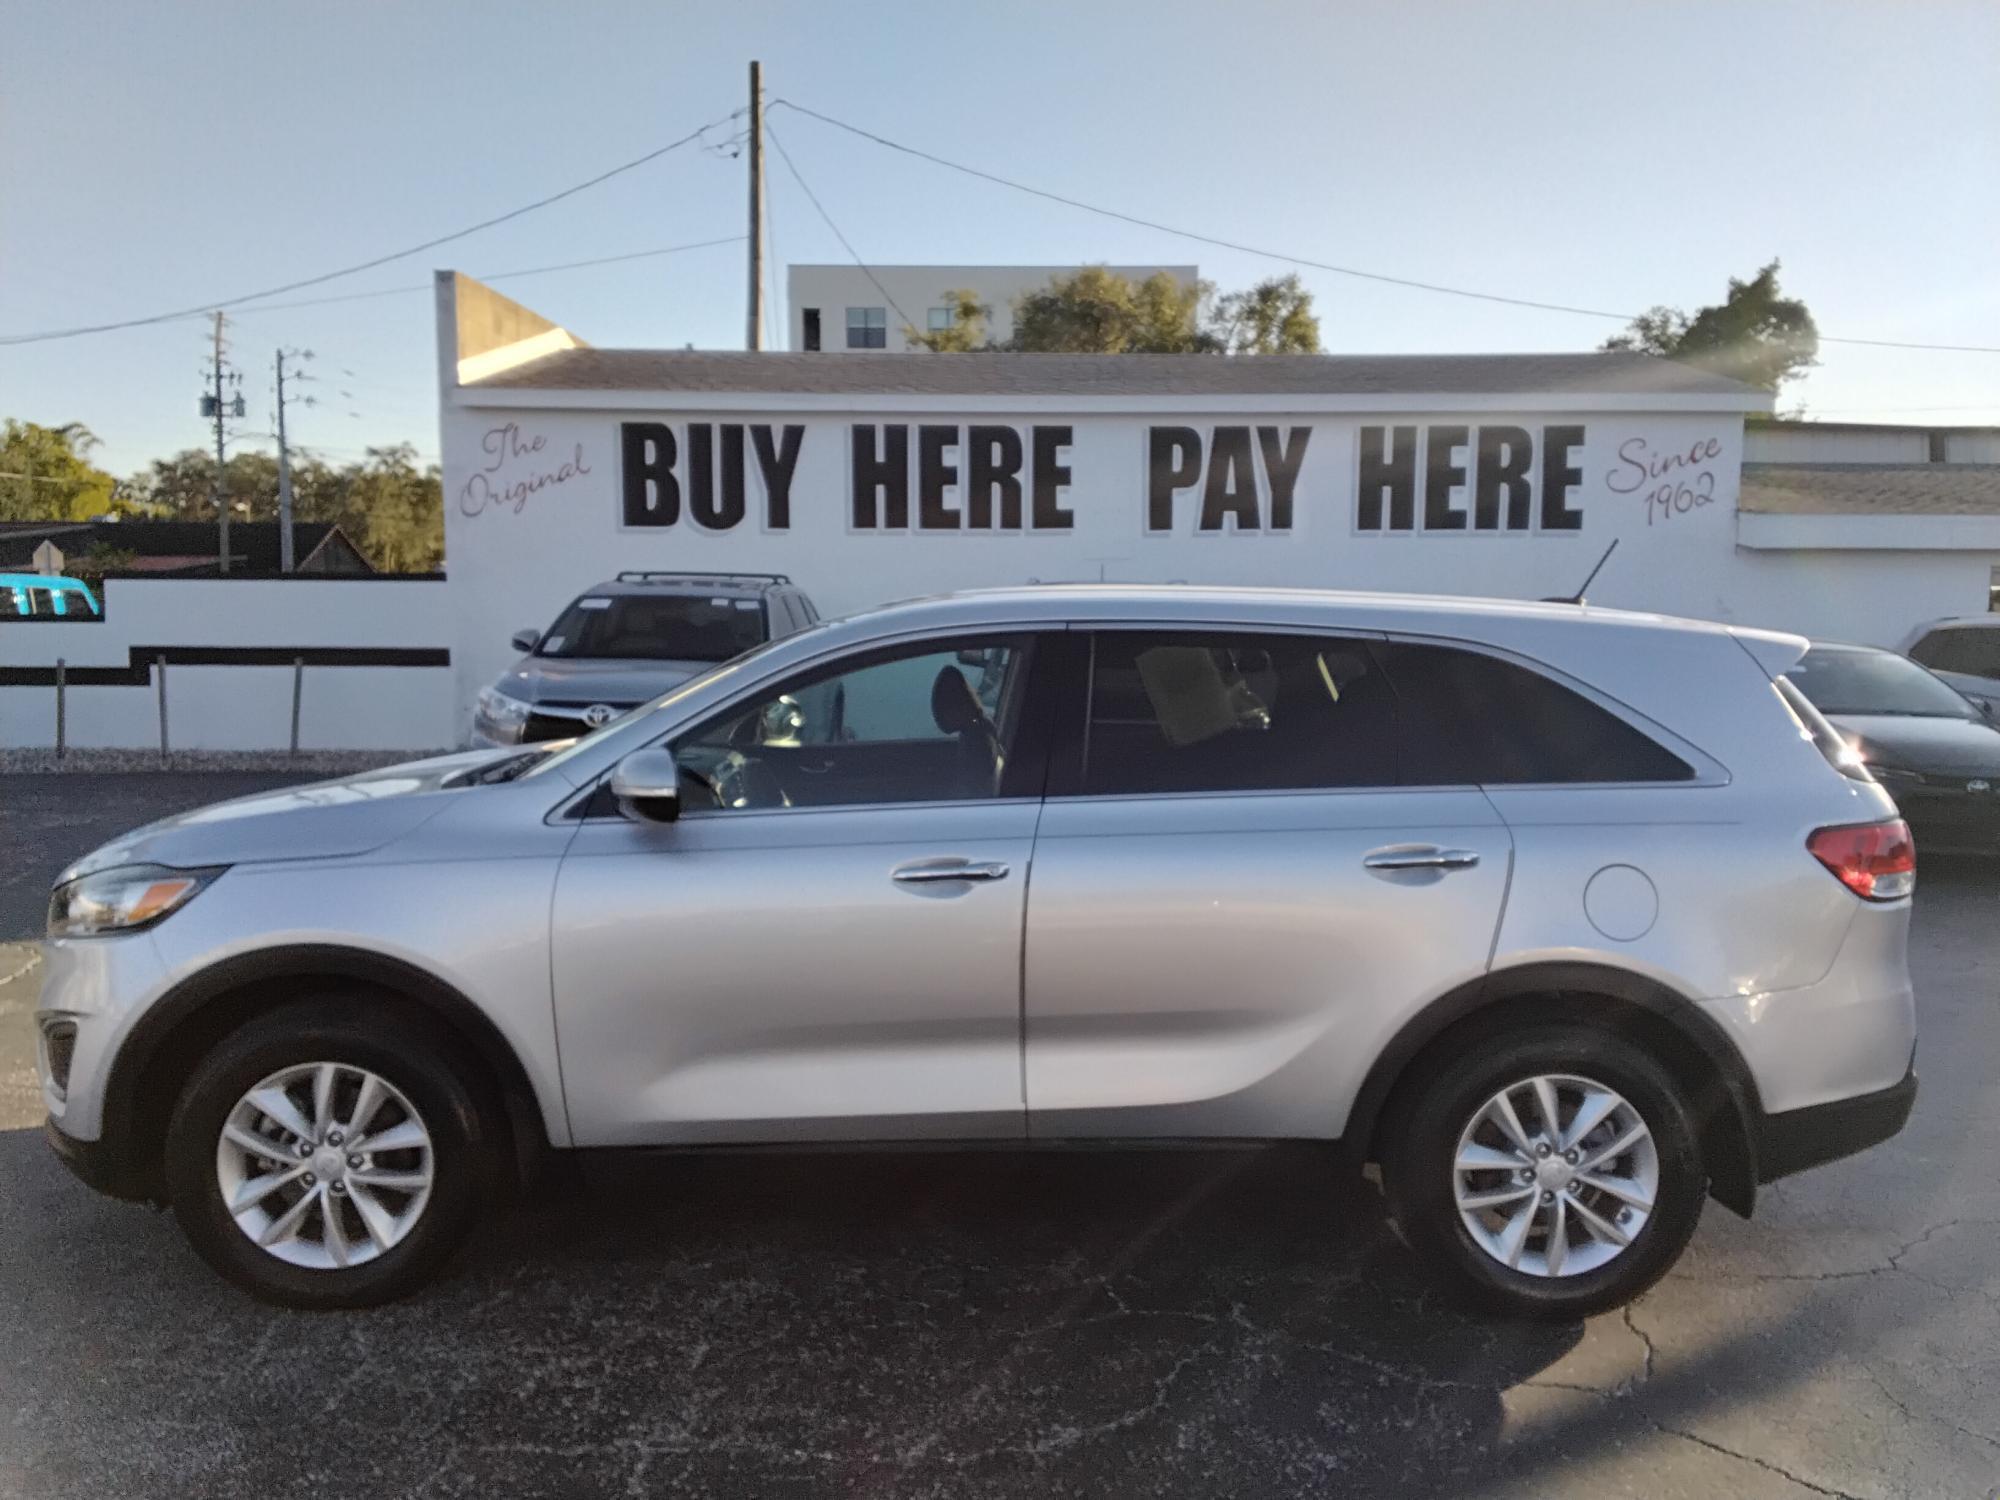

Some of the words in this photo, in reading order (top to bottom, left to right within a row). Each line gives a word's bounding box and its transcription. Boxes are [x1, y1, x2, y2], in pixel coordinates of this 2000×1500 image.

[482, 422, 547, 472] The
[1606, 437, 1722, 494] Since
[459, 442, 592, 518] Original
[621, 422, 805, 530] BUY
[852, 423, 1073, 530] HERE
[1148, 425, 1311, 531] PAY
[1357, 425, 1585, 531] HERE
[1645, 470, 1714, 526] 1962
